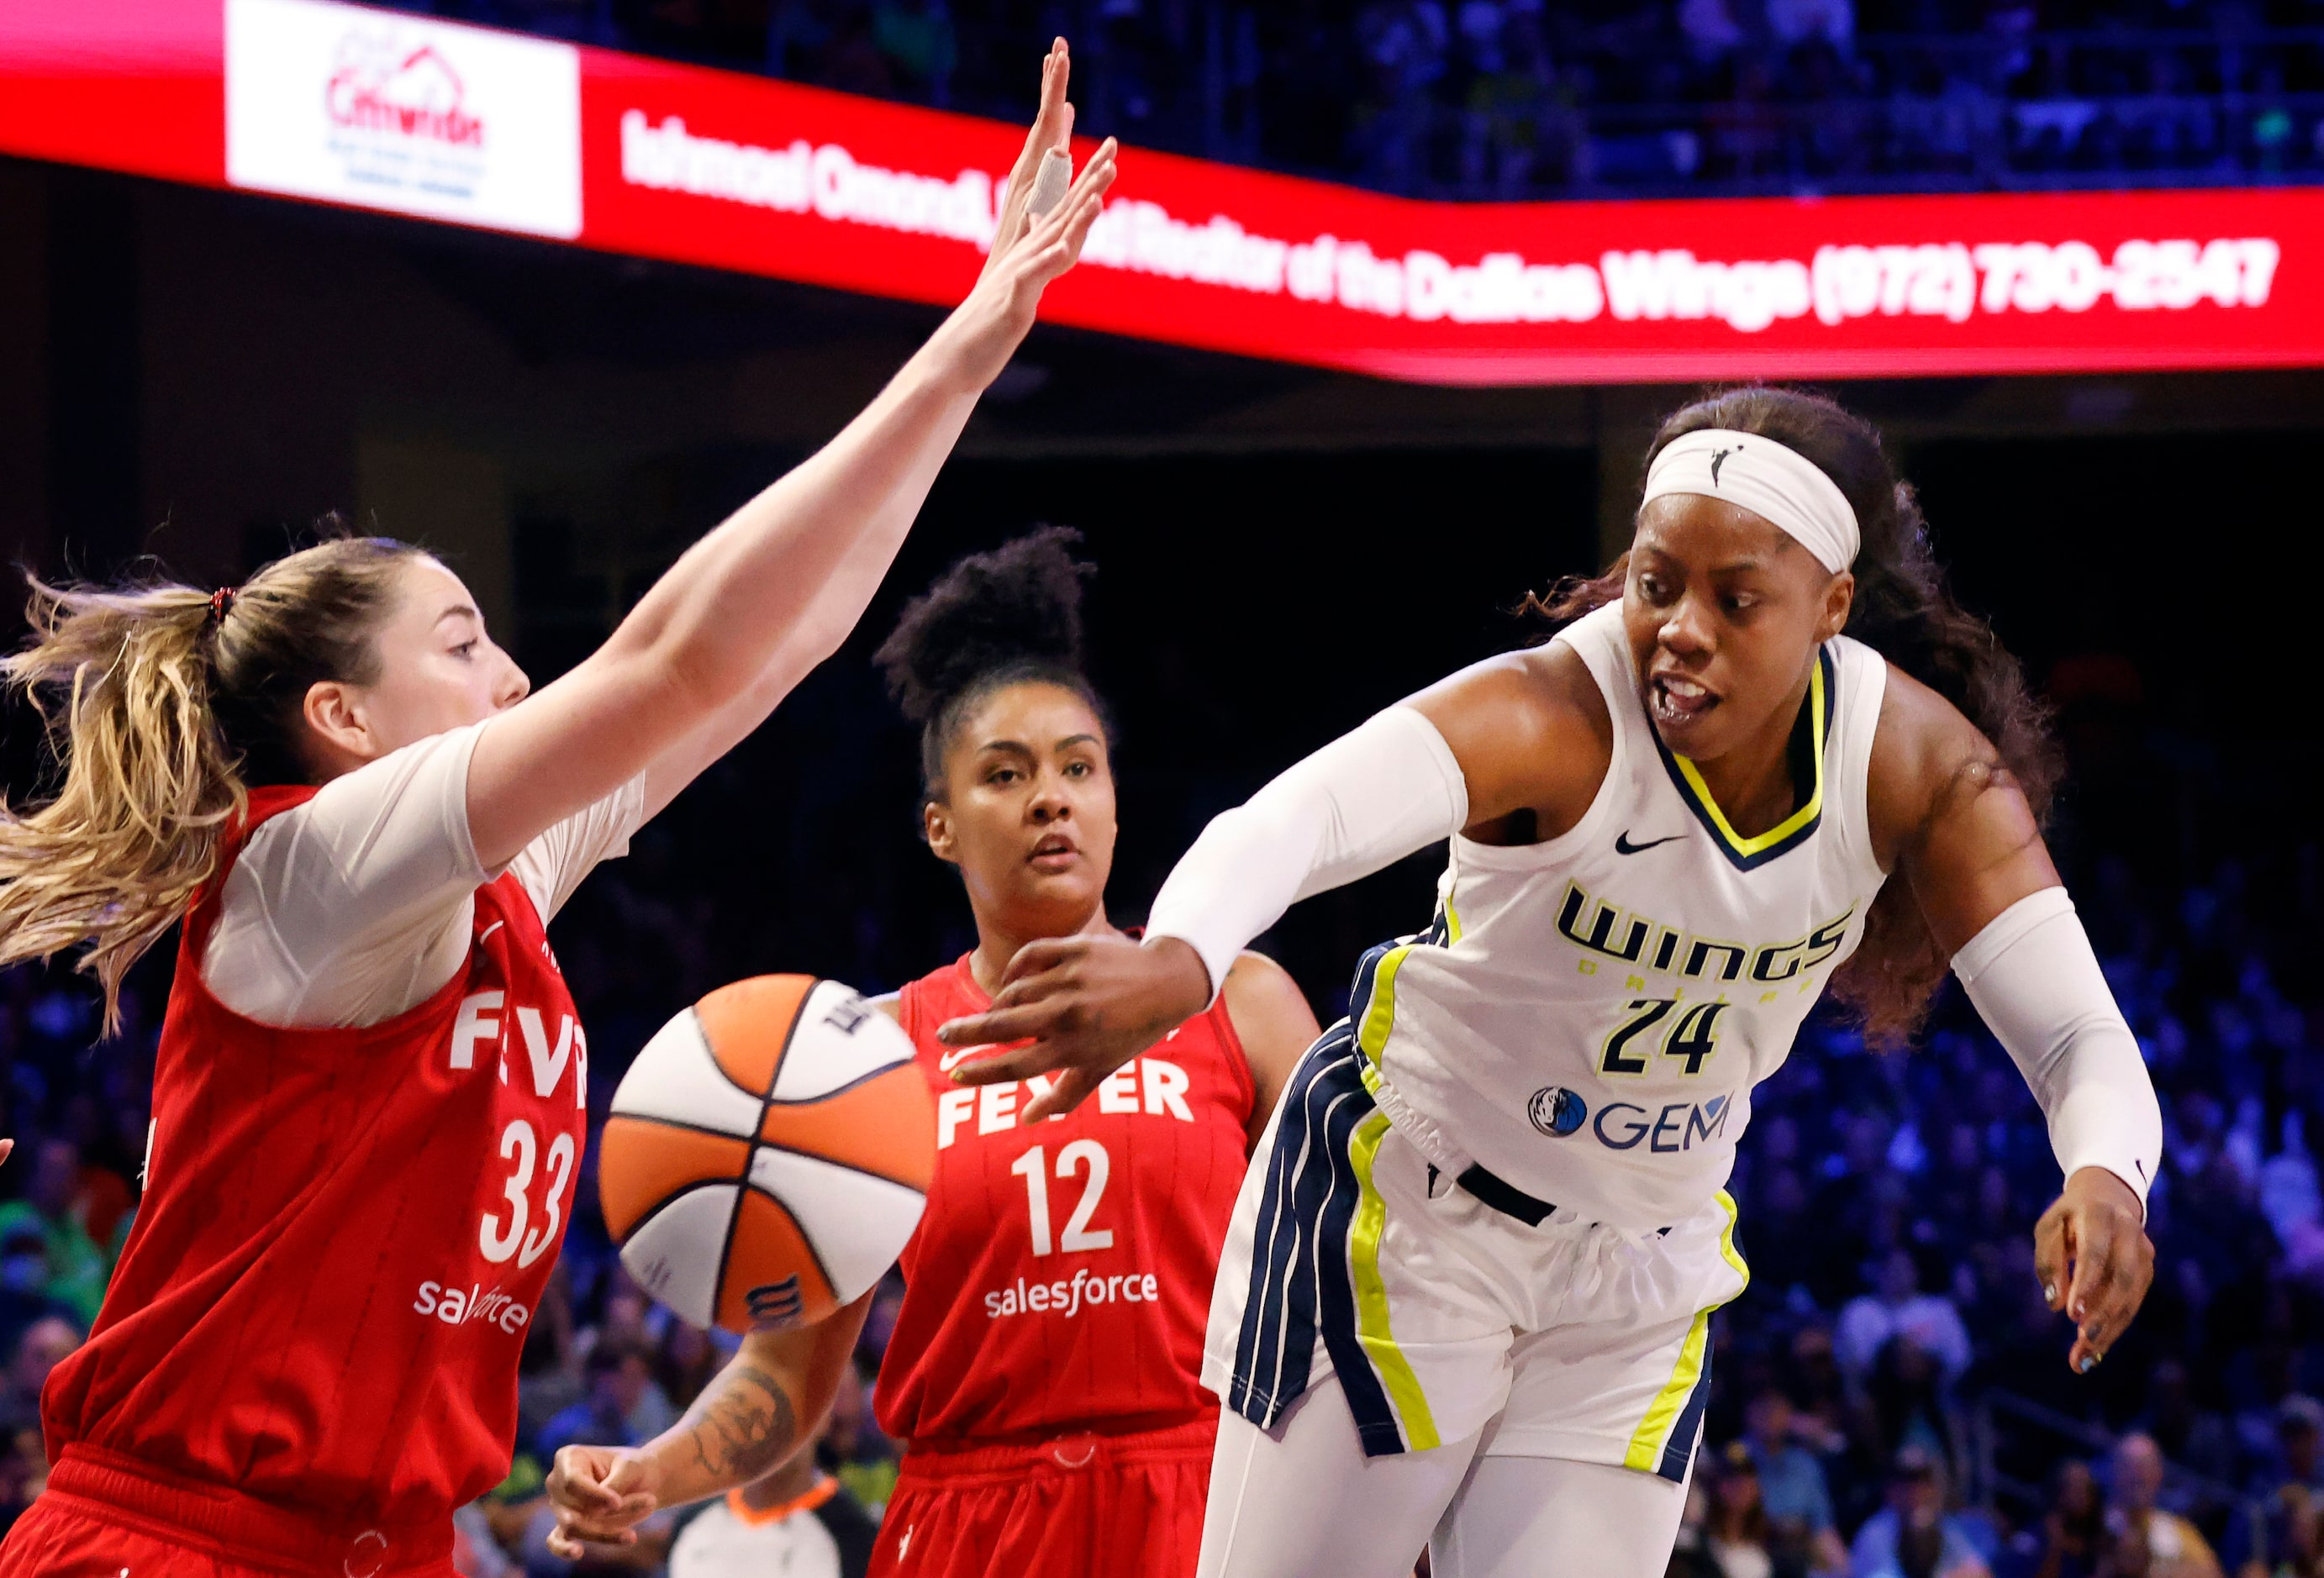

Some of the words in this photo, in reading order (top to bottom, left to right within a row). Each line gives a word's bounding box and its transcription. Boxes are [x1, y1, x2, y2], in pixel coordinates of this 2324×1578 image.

[1287, 235, 1335, 301] of
[1337, 243, 1402, 316] the
[1404, 251, 1601, 323] Dallas
[1603, 250, 1810, 332] Wings
[1813, 244, 1974, 325] (972)
[1976, 239, 2279, 313] 730-2547
[1599, 999, 1731, 1076] 24
[479, 1119, 574, 1270] 33
[1011, 1139, 1113, 1257] 12
[984, 1269, 1158, 1318] salesforce
